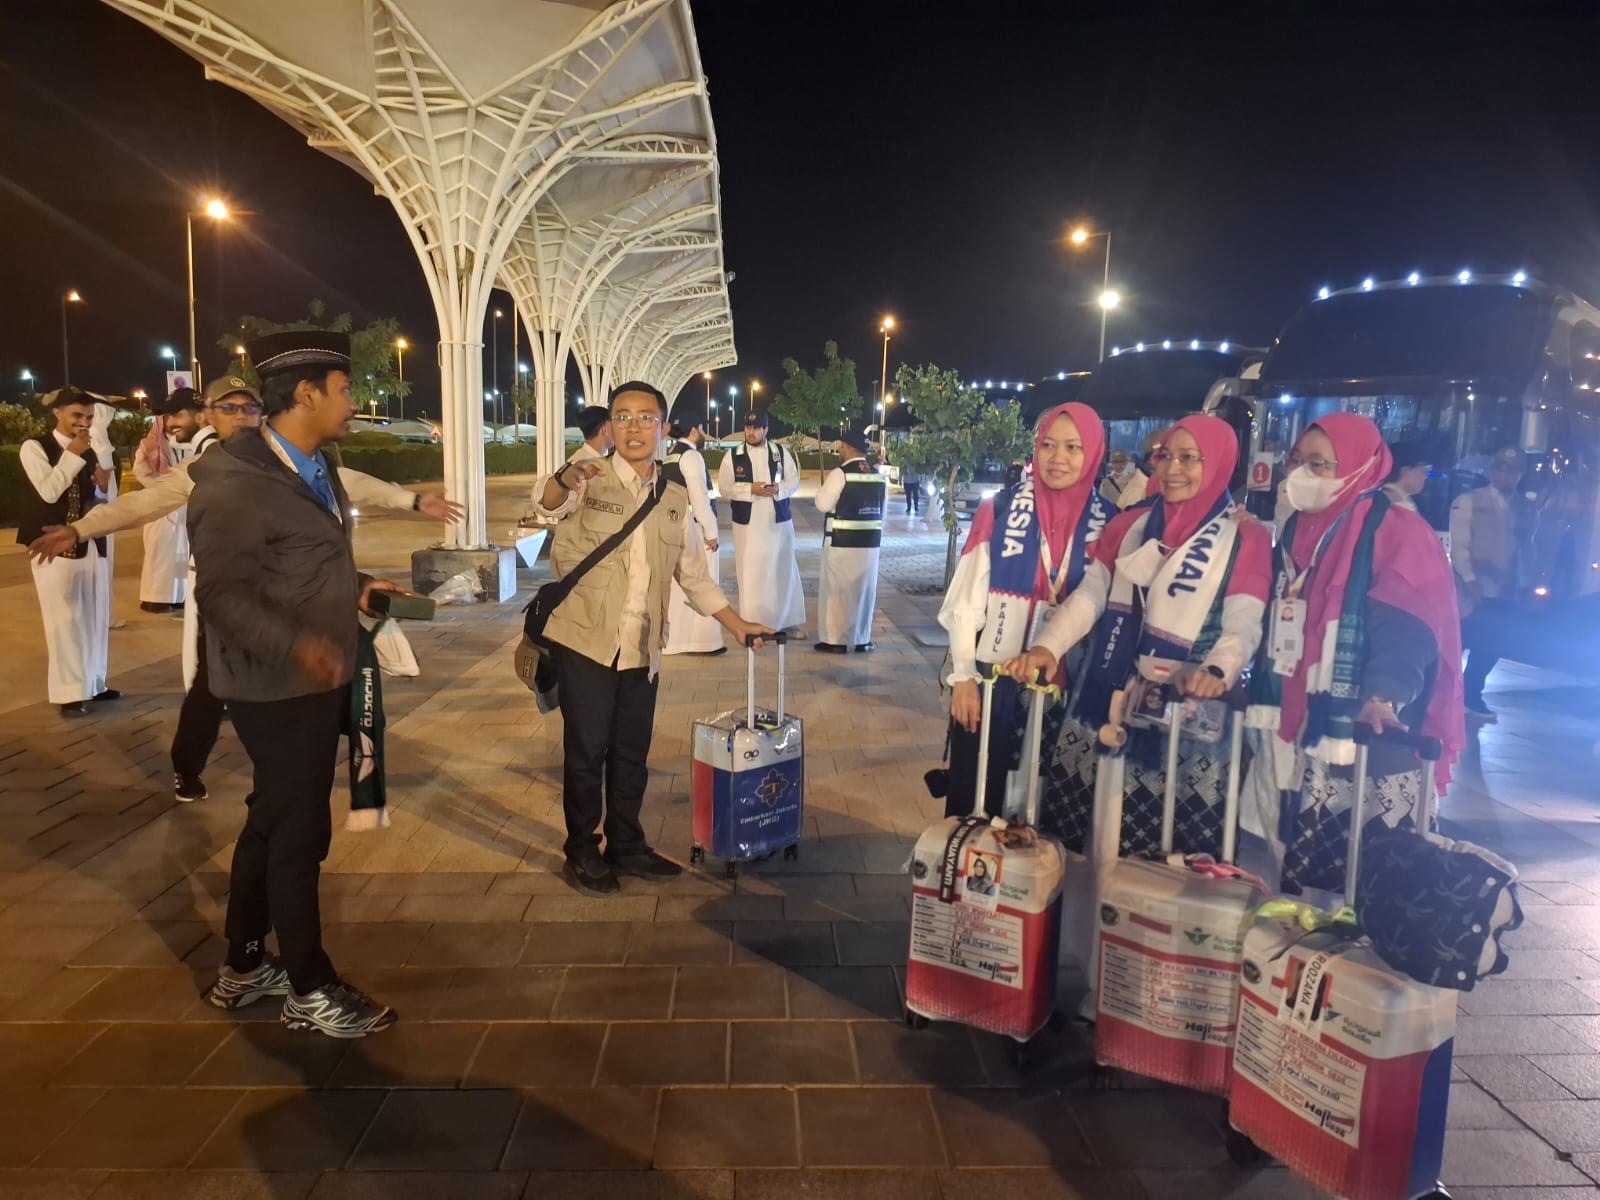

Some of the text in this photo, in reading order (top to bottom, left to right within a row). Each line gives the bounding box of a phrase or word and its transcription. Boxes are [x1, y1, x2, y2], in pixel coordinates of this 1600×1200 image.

[1001, 479, 1035, 558] NESIA
[993, 602, 1007, 653] FAJRUL
[359, 667, 374, 728] السعودية
[978, 960, 1000, 980] Haji
[1301, 955, 1327, 1006] ROOZANA
[1184, 1022, 1213, 1041] Haji
[1304, 1100, 1332, 1127] Haji
